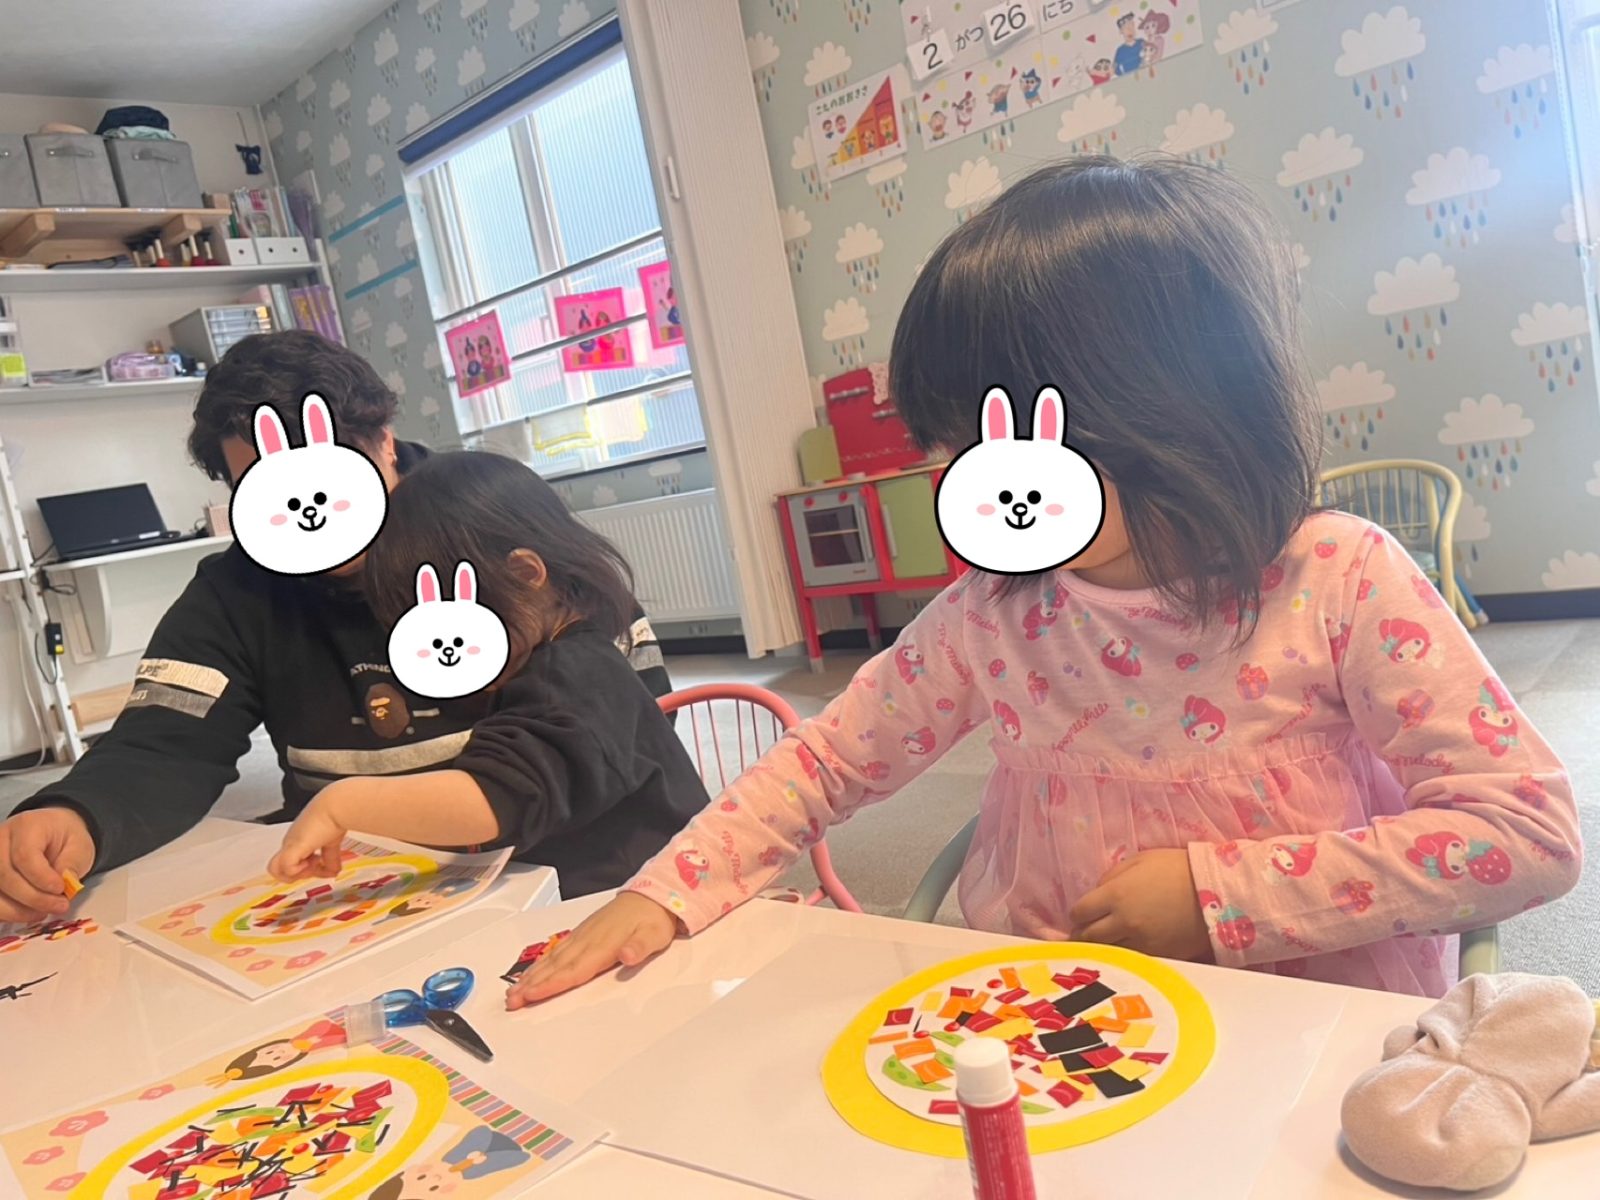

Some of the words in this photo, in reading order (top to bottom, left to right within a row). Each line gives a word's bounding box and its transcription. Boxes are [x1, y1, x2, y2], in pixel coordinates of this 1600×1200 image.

[922, 42, 943, 70] 2
[954, 26, 984, 51] がつ
[990, 4, 1027, 42] 26
[1042, 0, 1073, 22] にち
